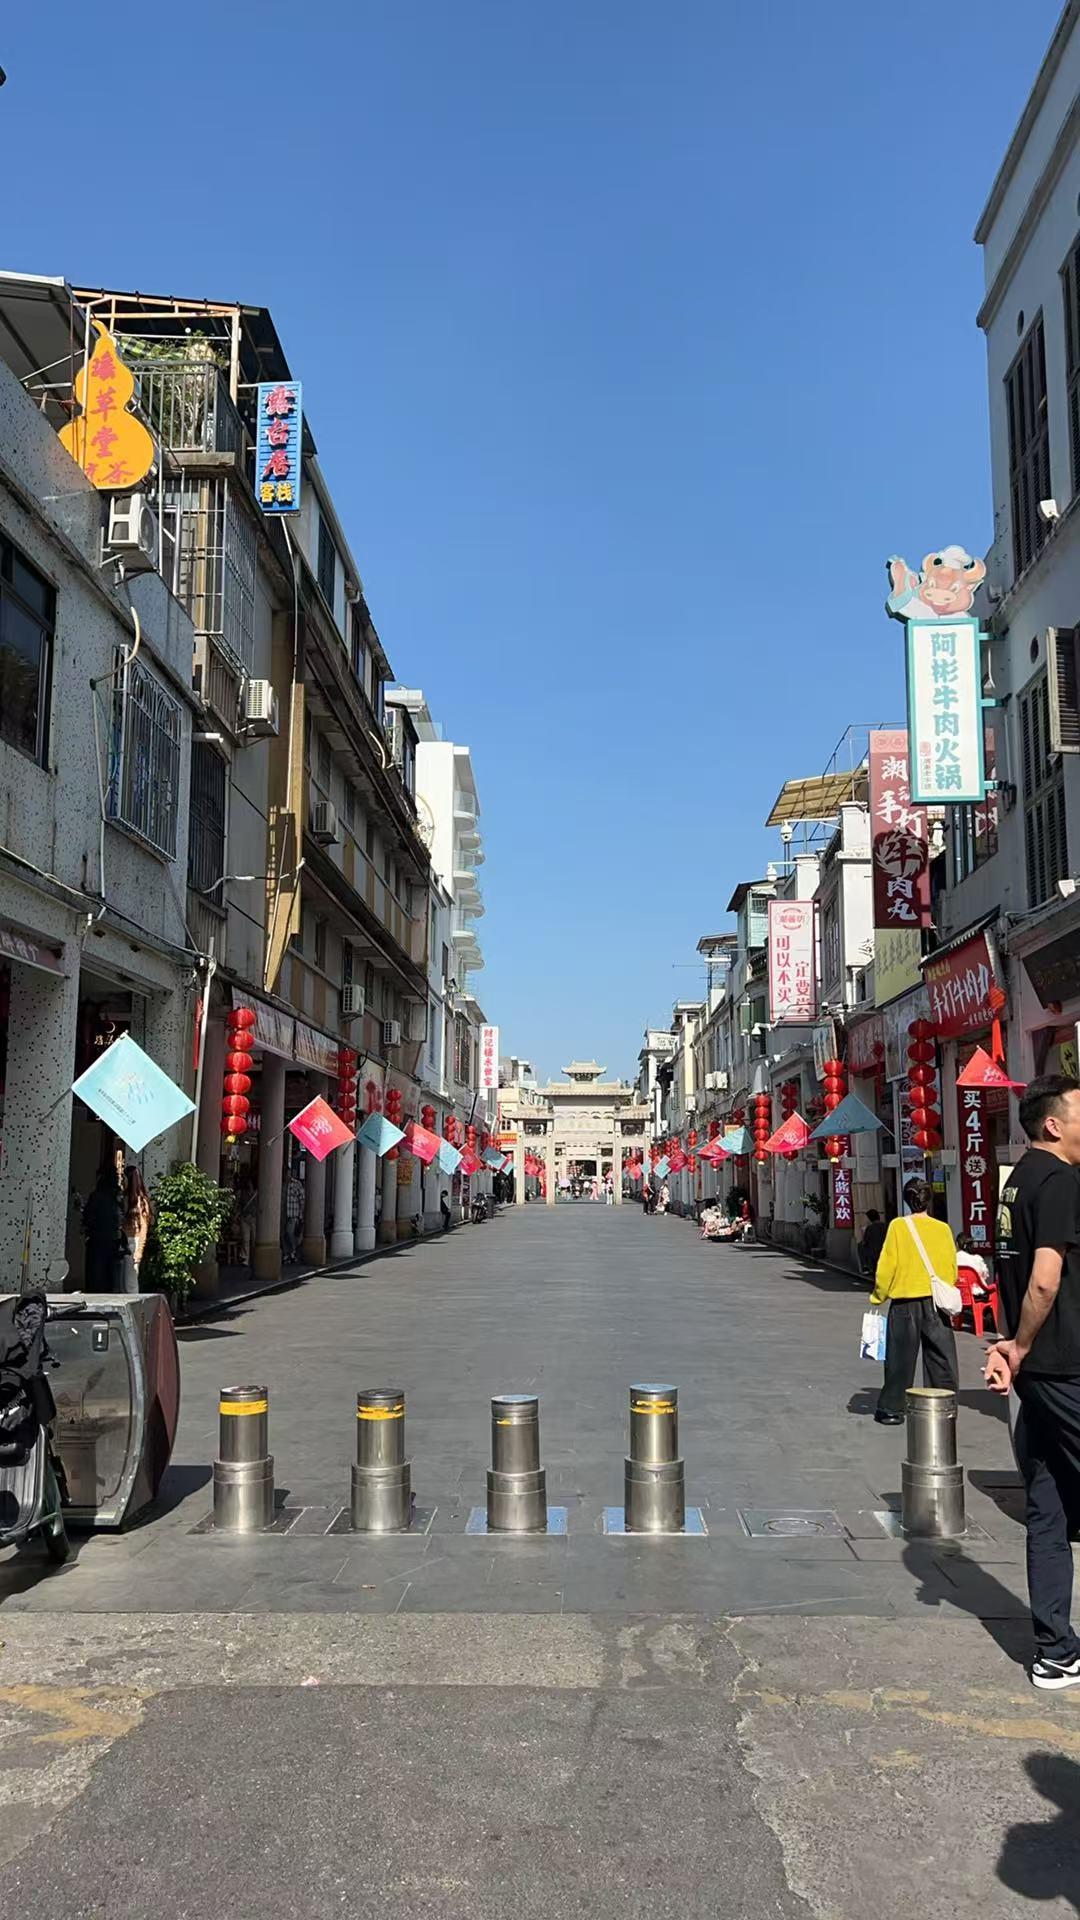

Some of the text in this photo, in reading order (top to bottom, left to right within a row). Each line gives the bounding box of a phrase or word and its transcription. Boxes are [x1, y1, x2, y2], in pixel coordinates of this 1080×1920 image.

[930, 631, 962, 791] 阿彬牛肉火锅
[875, 756, 926, 921] 潮手打牛肉丸
[777, 935, 792, 1003] 可以不买
[835, 1169, 851, 1220] 无酱不欢
[963, 1090, 988, 1222] 买4斤送1斤
